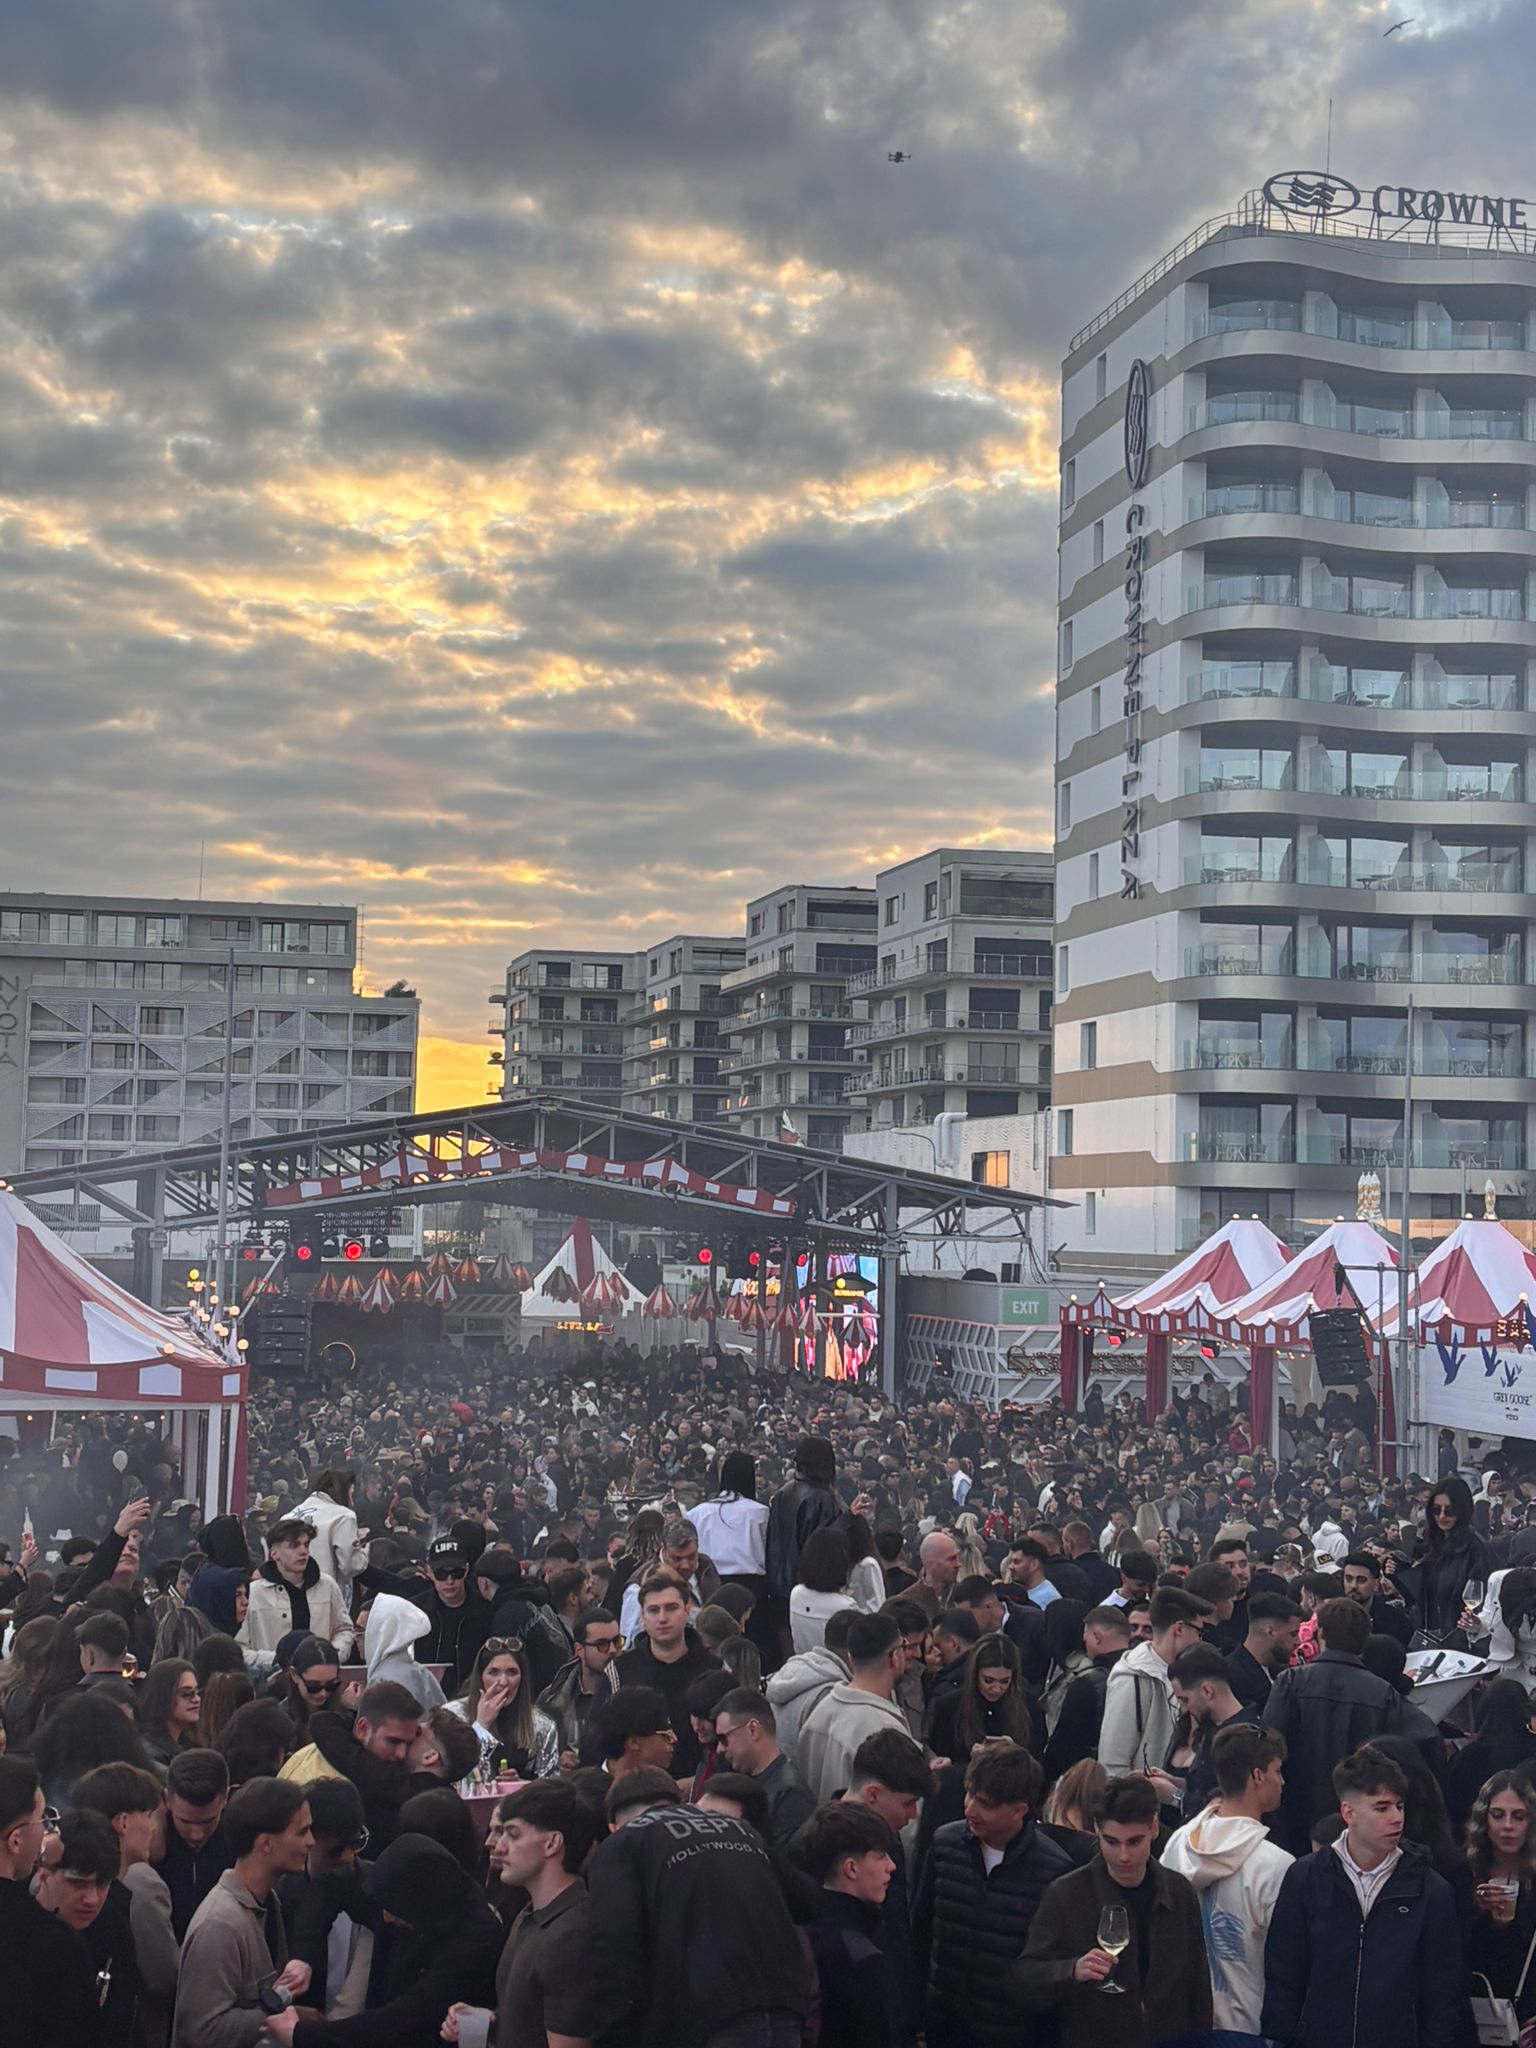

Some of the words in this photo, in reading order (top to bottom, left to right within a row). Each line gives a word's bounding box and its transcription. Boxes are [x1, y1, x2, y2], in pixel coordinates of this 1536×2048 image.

[1372, 184, 1526, 228] CROWNE
[1122, 503, 1145, 718] CROWNE
[1120, 737, 1141, 900] PLAZA
[1012, 1300, 1040, 1315] EXIT
[664, 1818, 754, 1840] DEPT.
